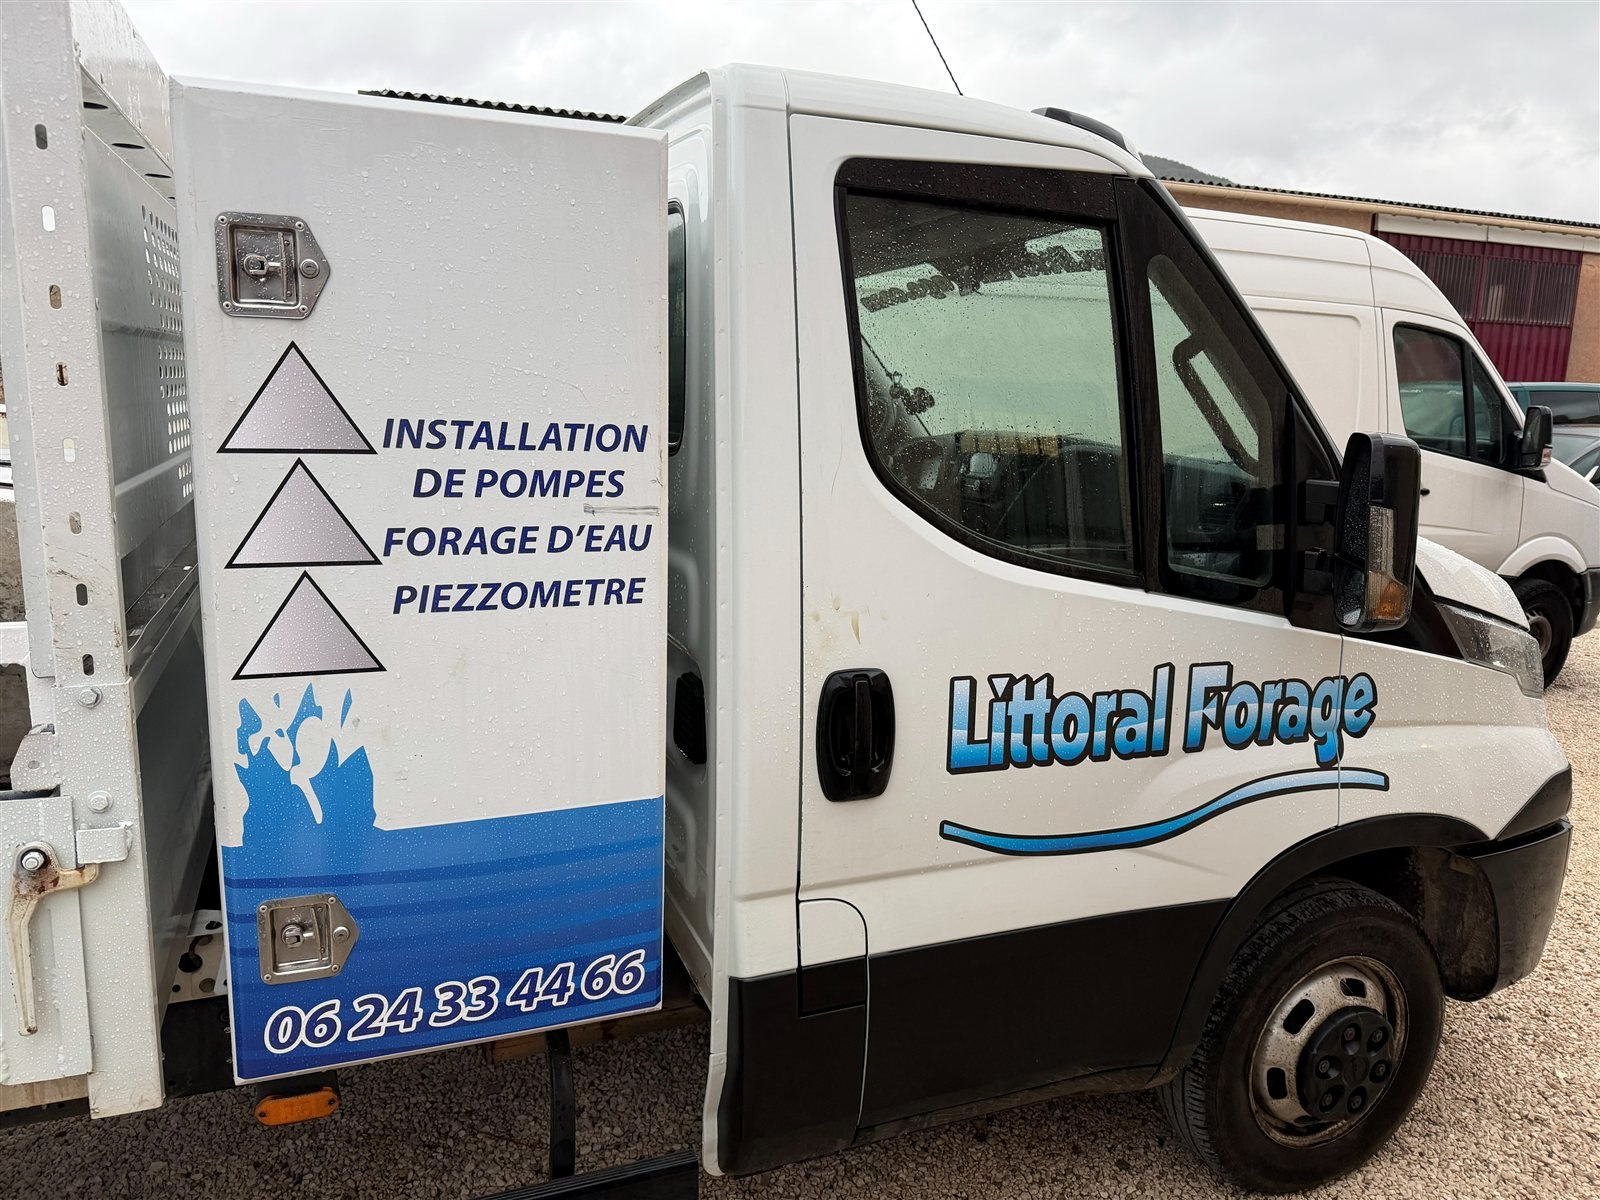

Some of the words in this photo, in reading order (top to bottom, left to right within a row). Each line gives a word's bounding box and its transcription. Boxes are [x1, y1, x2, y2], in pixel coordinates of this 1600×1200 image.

[383, 418, 648, 452] INSTALLATION
[412, 468, 466, 498] DE
[475, 469, 625, 498] POMPES
[383, 526, 539, 557] FORAGE
[547, 524, 652, 553] D'EAU
[393, 577, 646, 614] PIEZZOMETRE
[946, 662, 1176, 774] Littoral
[1183, 661, 1378, 767] Forage
[264, 1000, 341, 1054] 06
[347, 987, 423, 1041] 24
[429, 975, 500, 1027] 33
[506, 962, 575, 1011] 44
[581, 949, 646, 1000] 66
